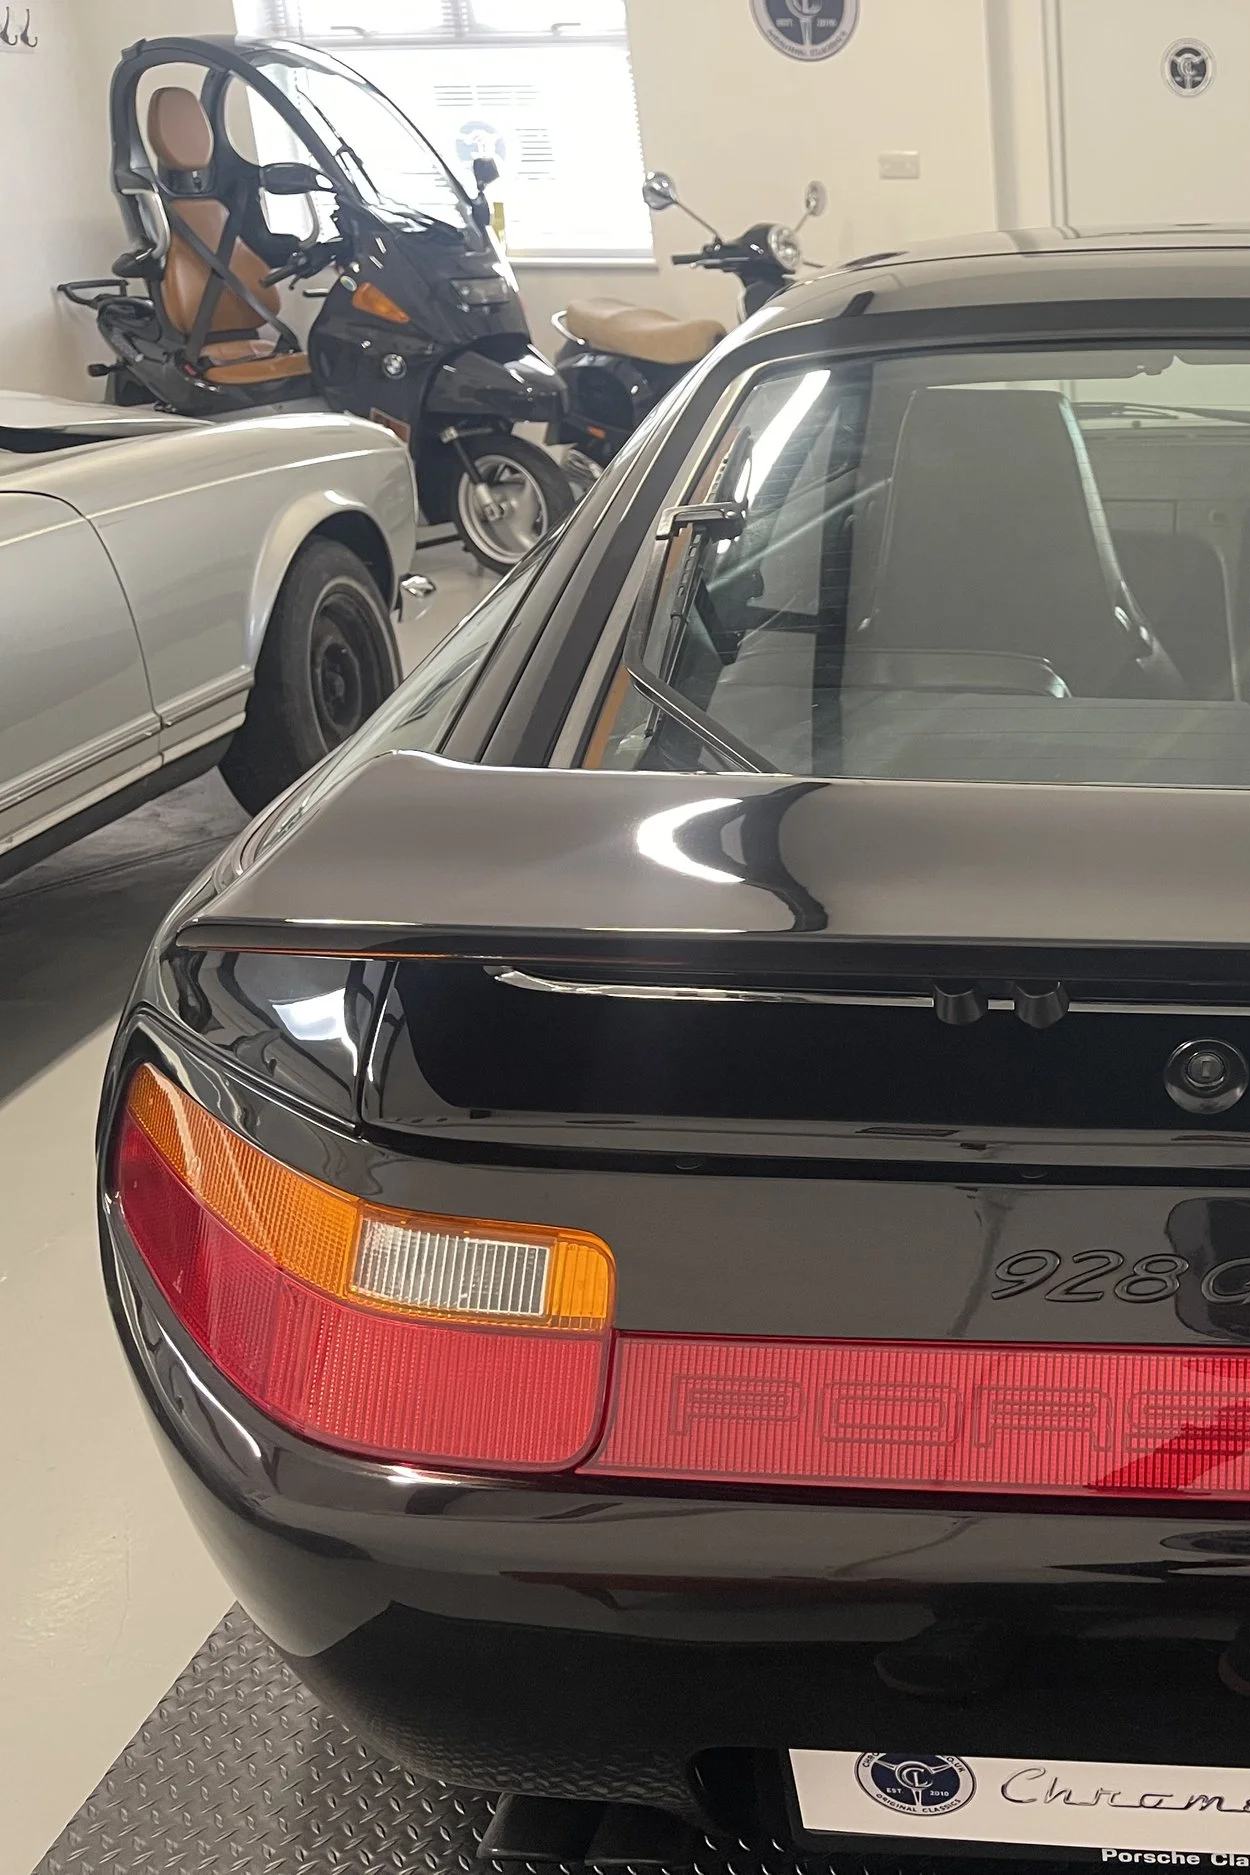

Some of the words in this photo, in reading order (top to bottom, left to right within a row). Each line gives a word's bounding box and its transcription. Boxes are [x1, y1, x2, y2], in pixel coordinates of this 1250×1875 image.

[990, 1249, 1190, 1304] 928
[875, 1793, 918, 1813] ORIGINAL
[921, 1799, 961, 1813] CLASSICS
[1101, 1848, 1200, 1866] Porsche
